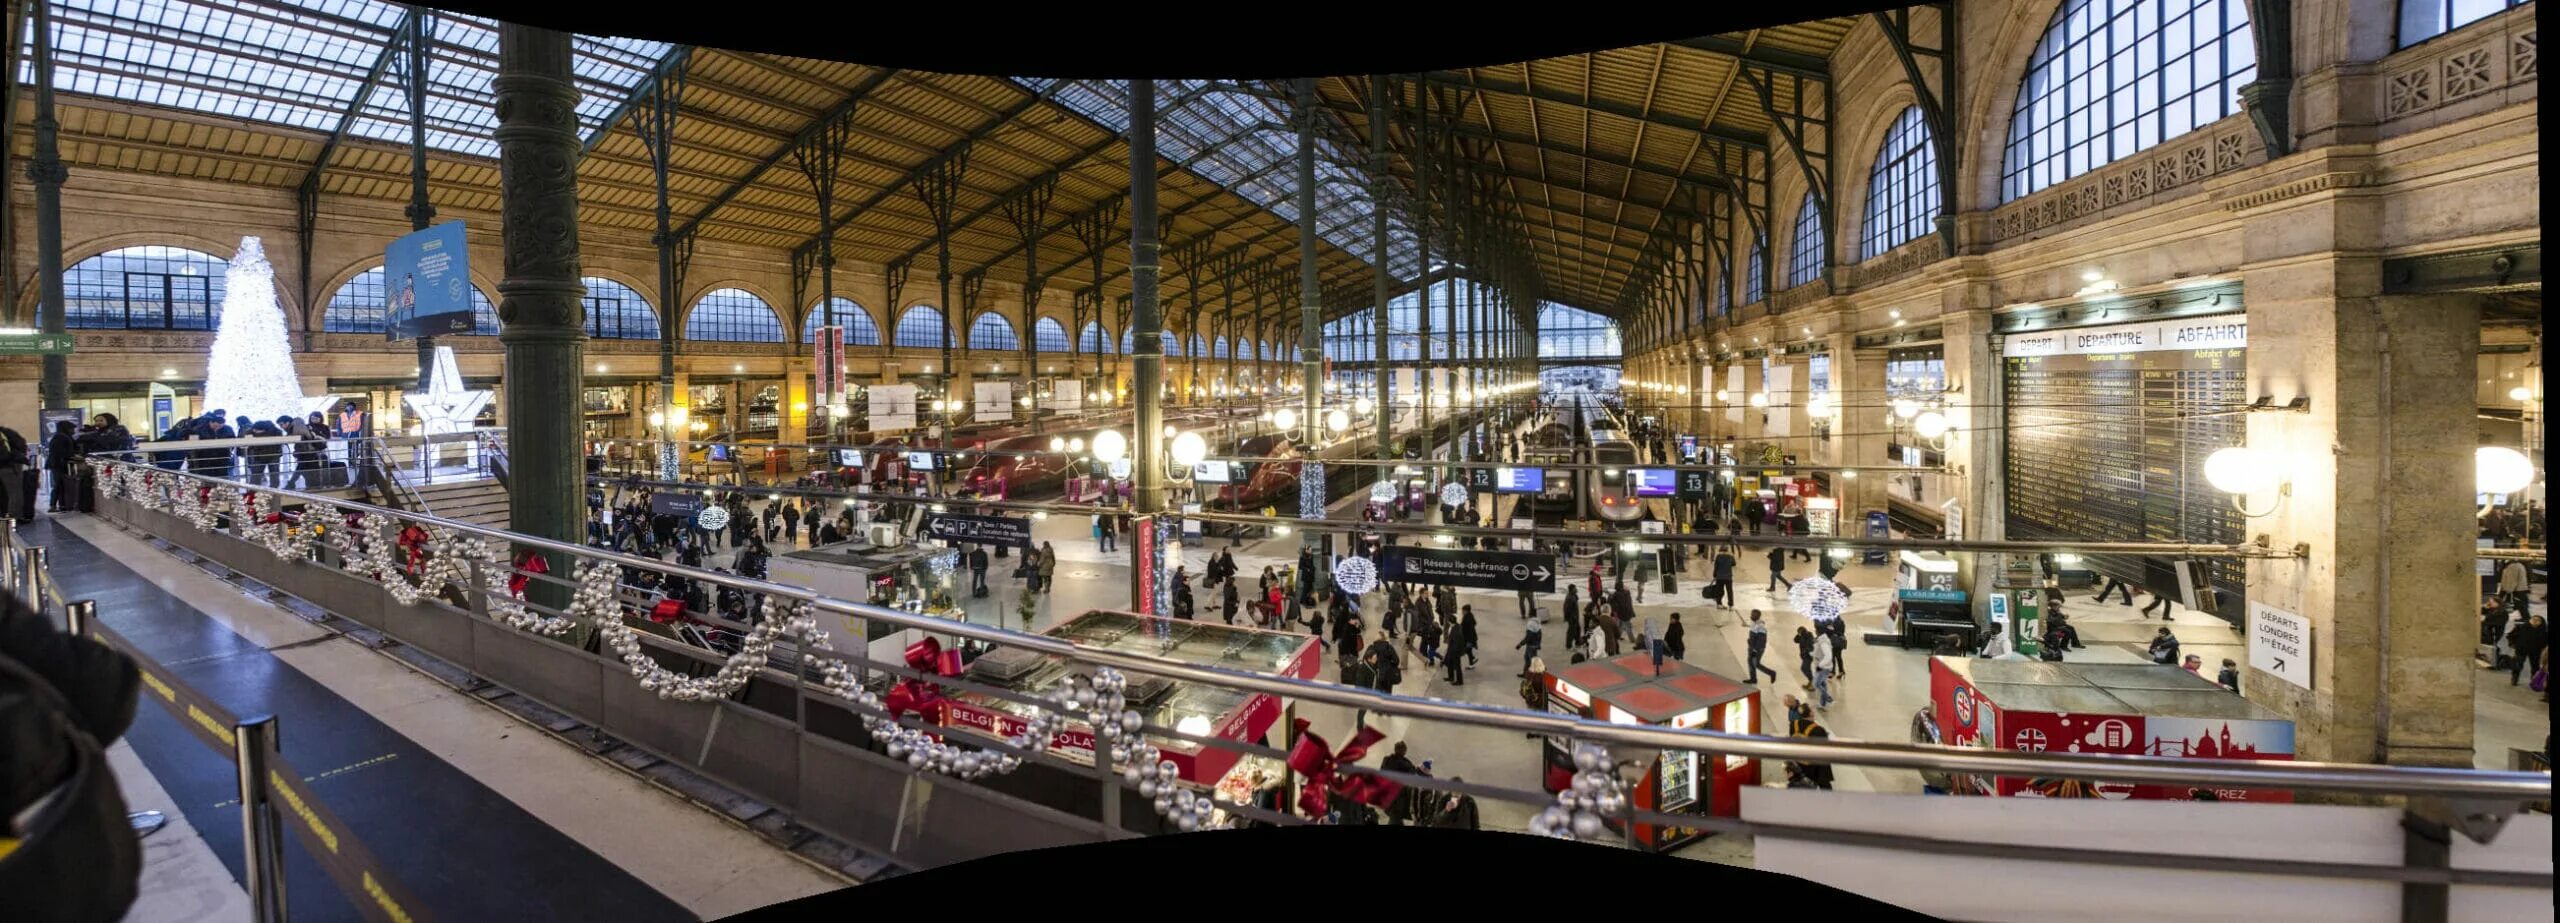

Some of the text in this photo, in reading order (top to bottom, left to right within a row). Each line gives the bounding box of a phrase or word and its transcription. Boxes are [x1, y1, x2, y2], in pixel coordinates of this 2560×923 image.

[2177, 323, 2247, 343] ABFAHRT
[1475, 474, 1489, 485] 12
[1687, 479, 1702, 490] 13
[1423, 558, 1453, 568] Réseau
[2261, 610, 2299, 631] DÉPARTS
[2260, 624, 2300, 644] LONDRES
[952, 708, 1012, 733] BELGIAN
